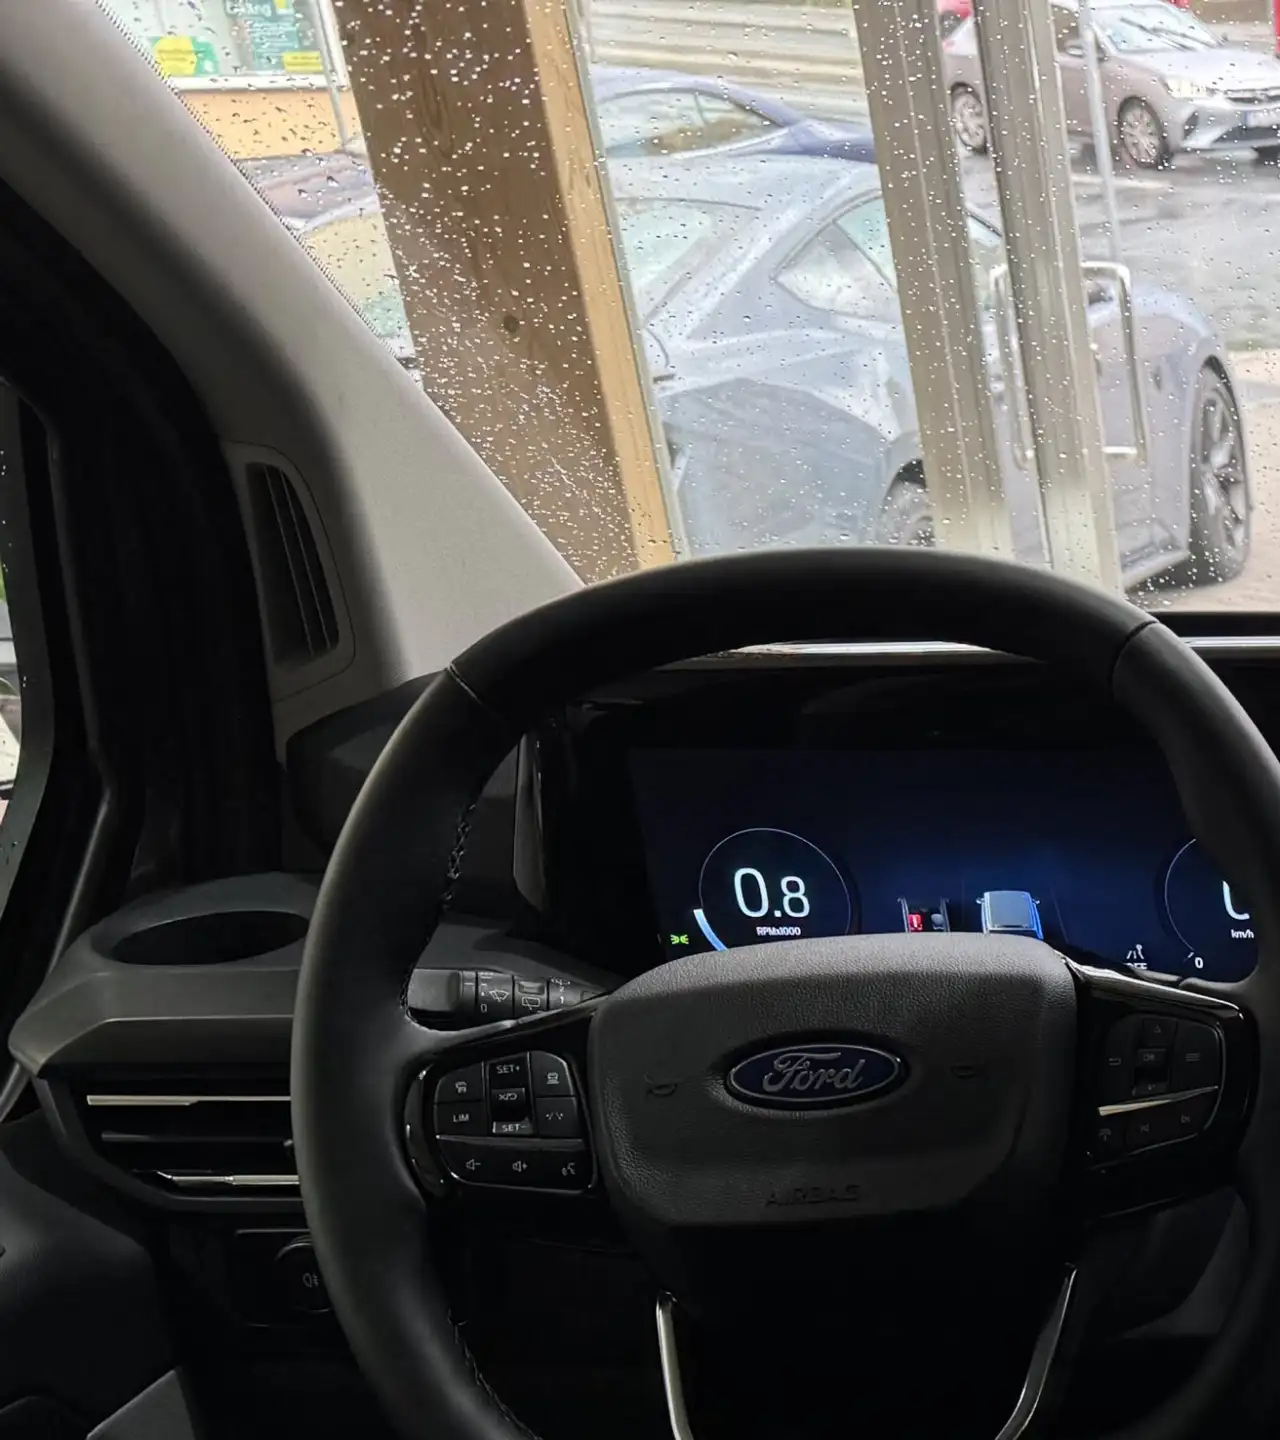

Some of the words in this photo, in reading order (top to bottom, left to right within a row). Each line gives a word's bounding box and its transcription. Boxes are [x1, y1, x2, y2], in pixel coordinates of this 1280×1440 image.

[733, 866, 811, 919] 0.8
[1231, 928, 1255, 940] km/h
[1194, 957, 1204, 970] 0
[761, 1050, 867, 1093] Ford
[452, 1113, 470, 1123] LIM
